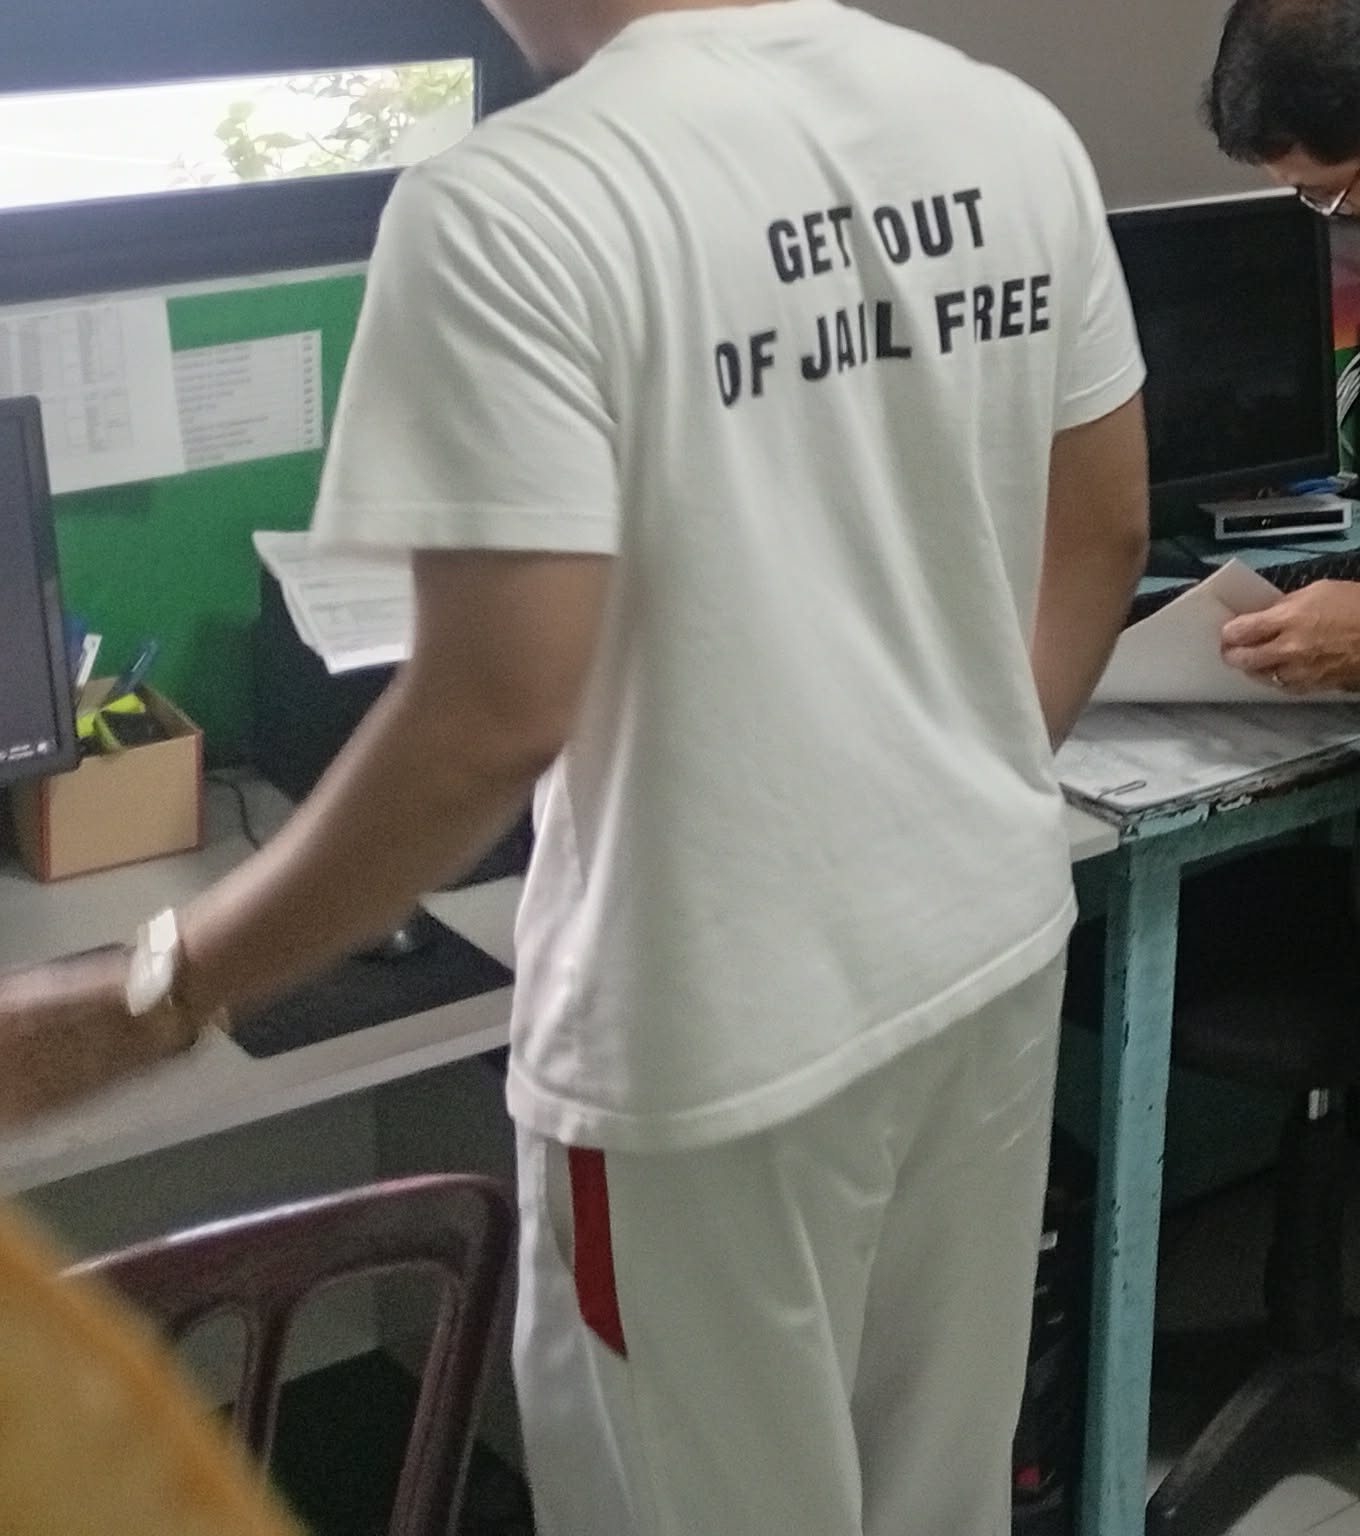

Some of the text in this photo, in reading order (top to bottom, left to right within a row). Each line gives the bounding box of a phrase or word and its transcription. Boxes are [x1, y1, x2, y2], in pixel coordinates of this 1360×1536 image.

[768, 188, 985, 283] GET OUT
[715, 274, 1051, 409] OF JAIL FREE
